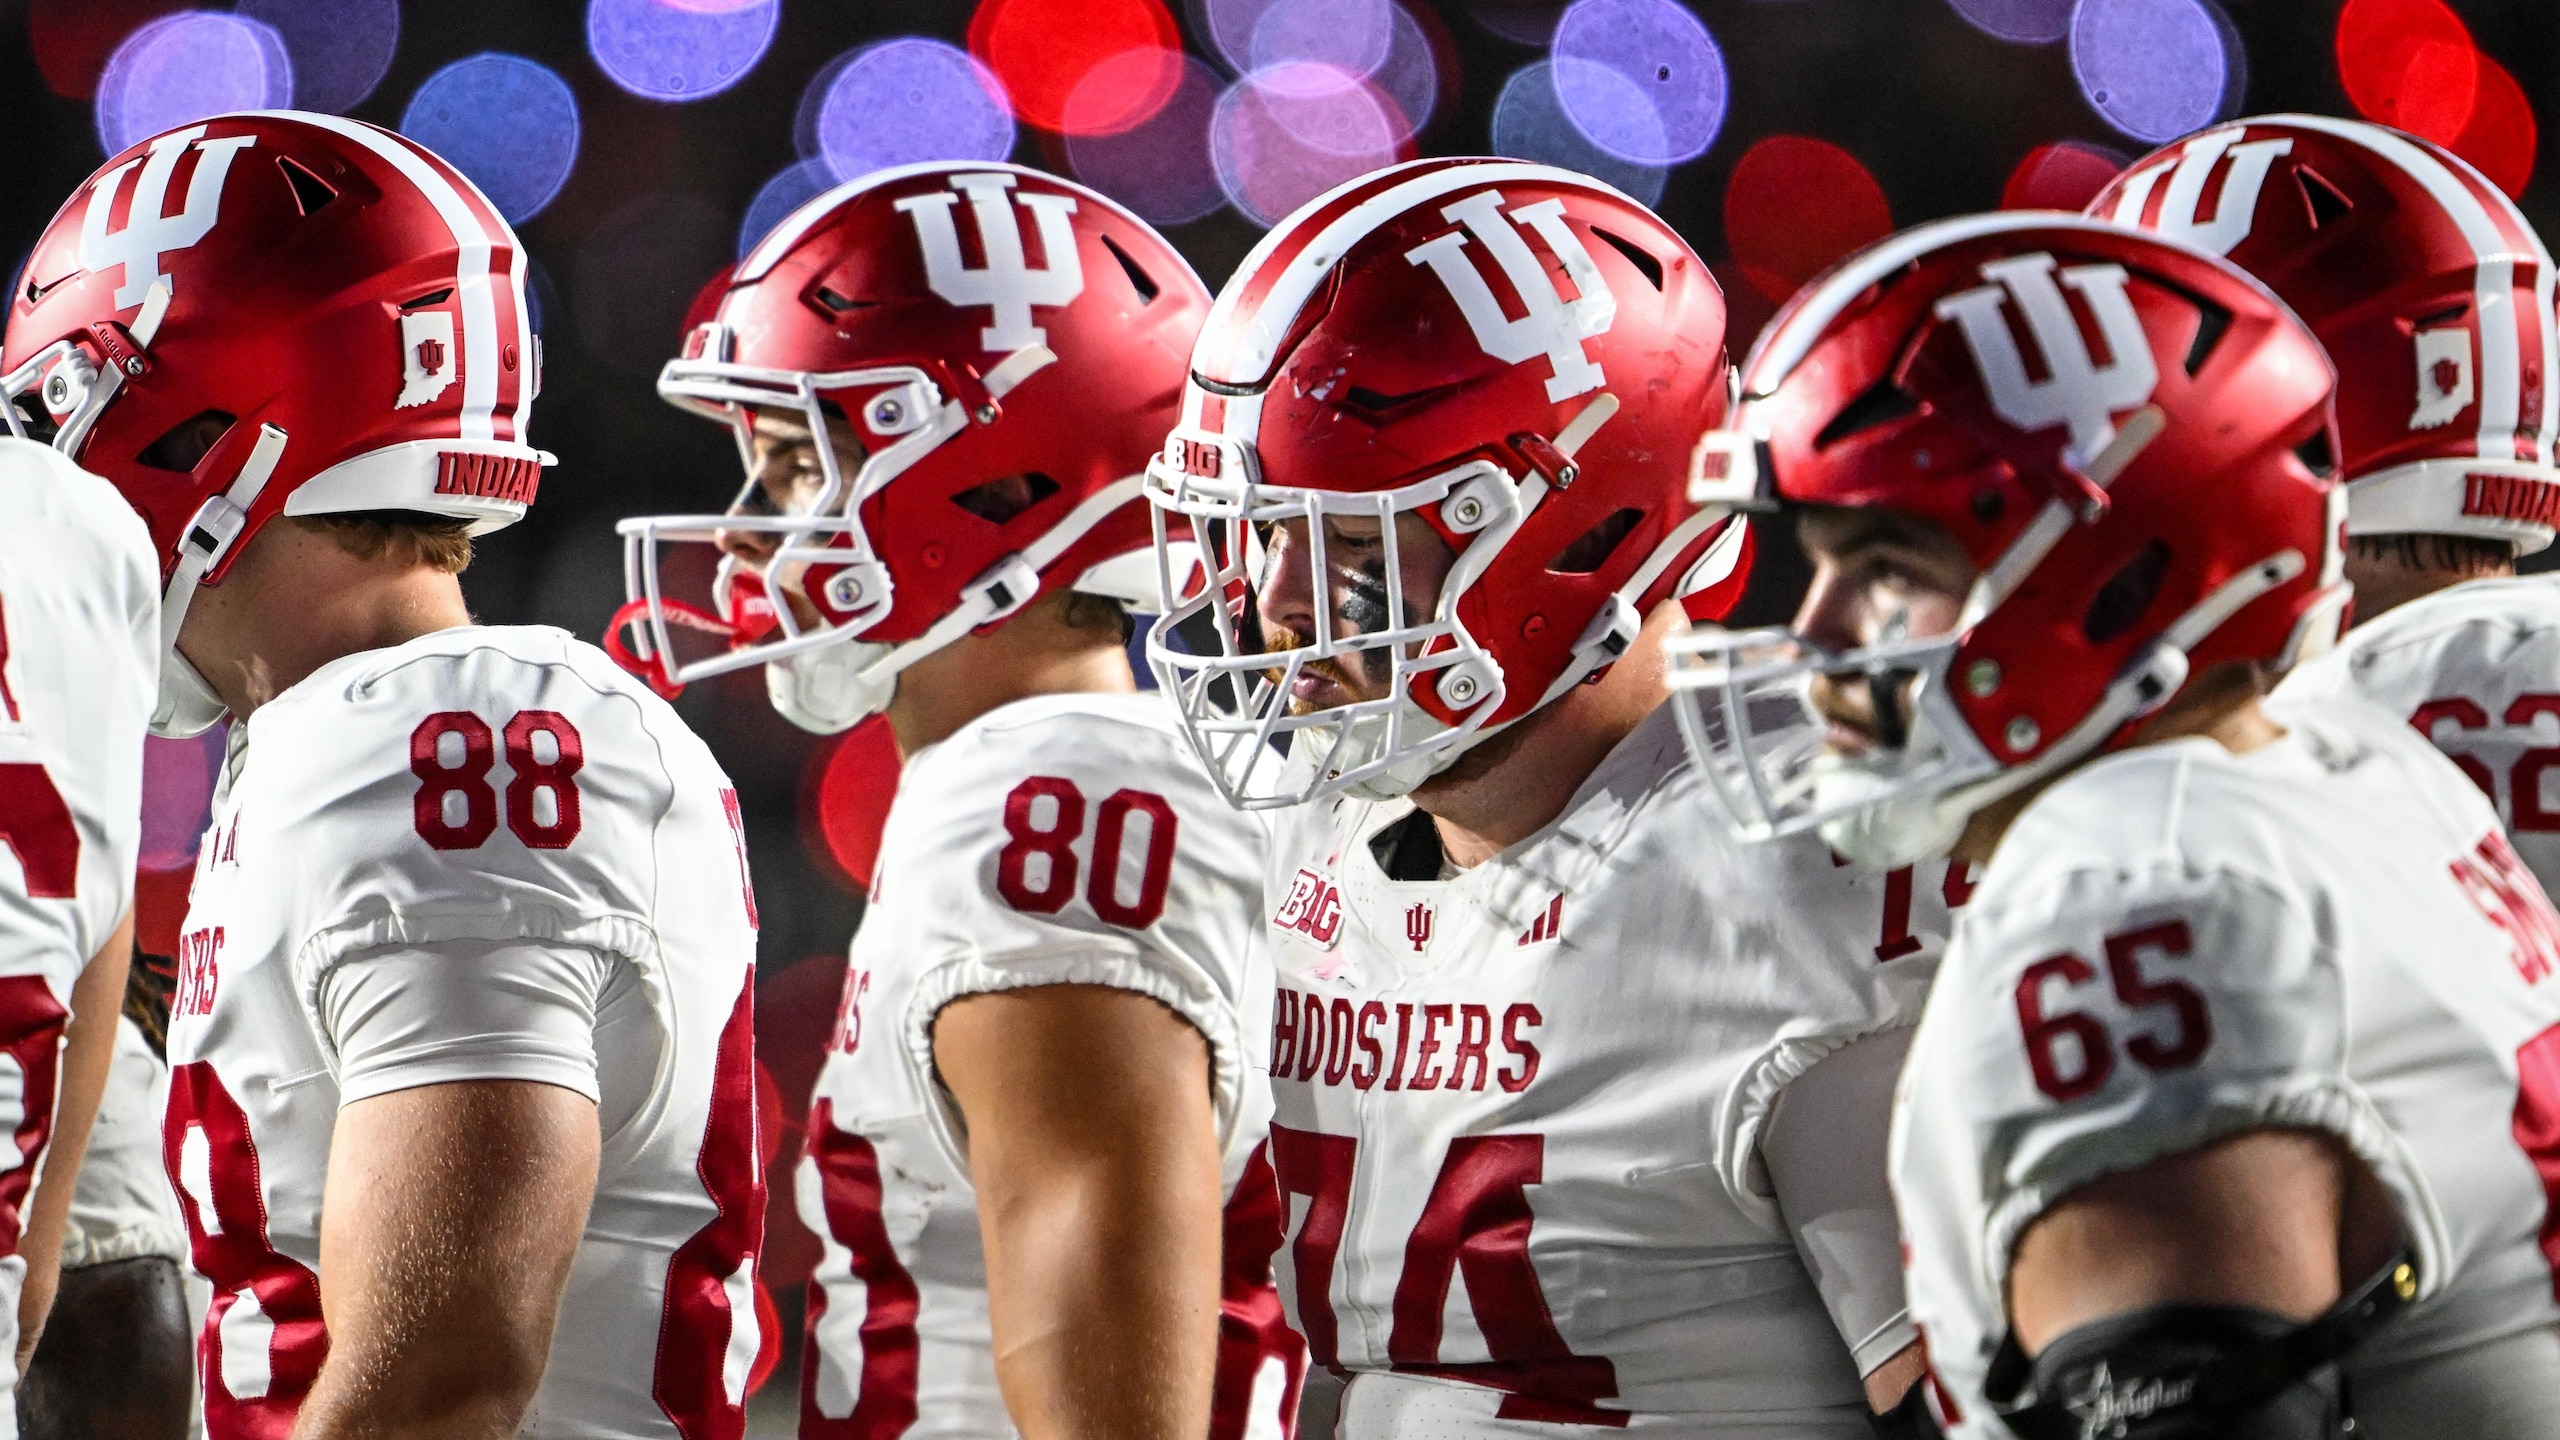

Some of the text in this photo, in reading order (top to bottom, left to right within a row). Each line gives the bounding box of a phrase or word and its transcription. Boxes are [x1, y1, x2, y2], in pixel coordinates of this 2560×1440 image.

[99, 328, 128, 366] Riddell
[410, 710, 584, 850] 88
[997, 774, 1179, 931] 80
[1269, 987, 1545, 1094] HOOSIERS
[2014, 916, 2213, 1103] 65
[1267, 1120, 1633, 1428] 74
